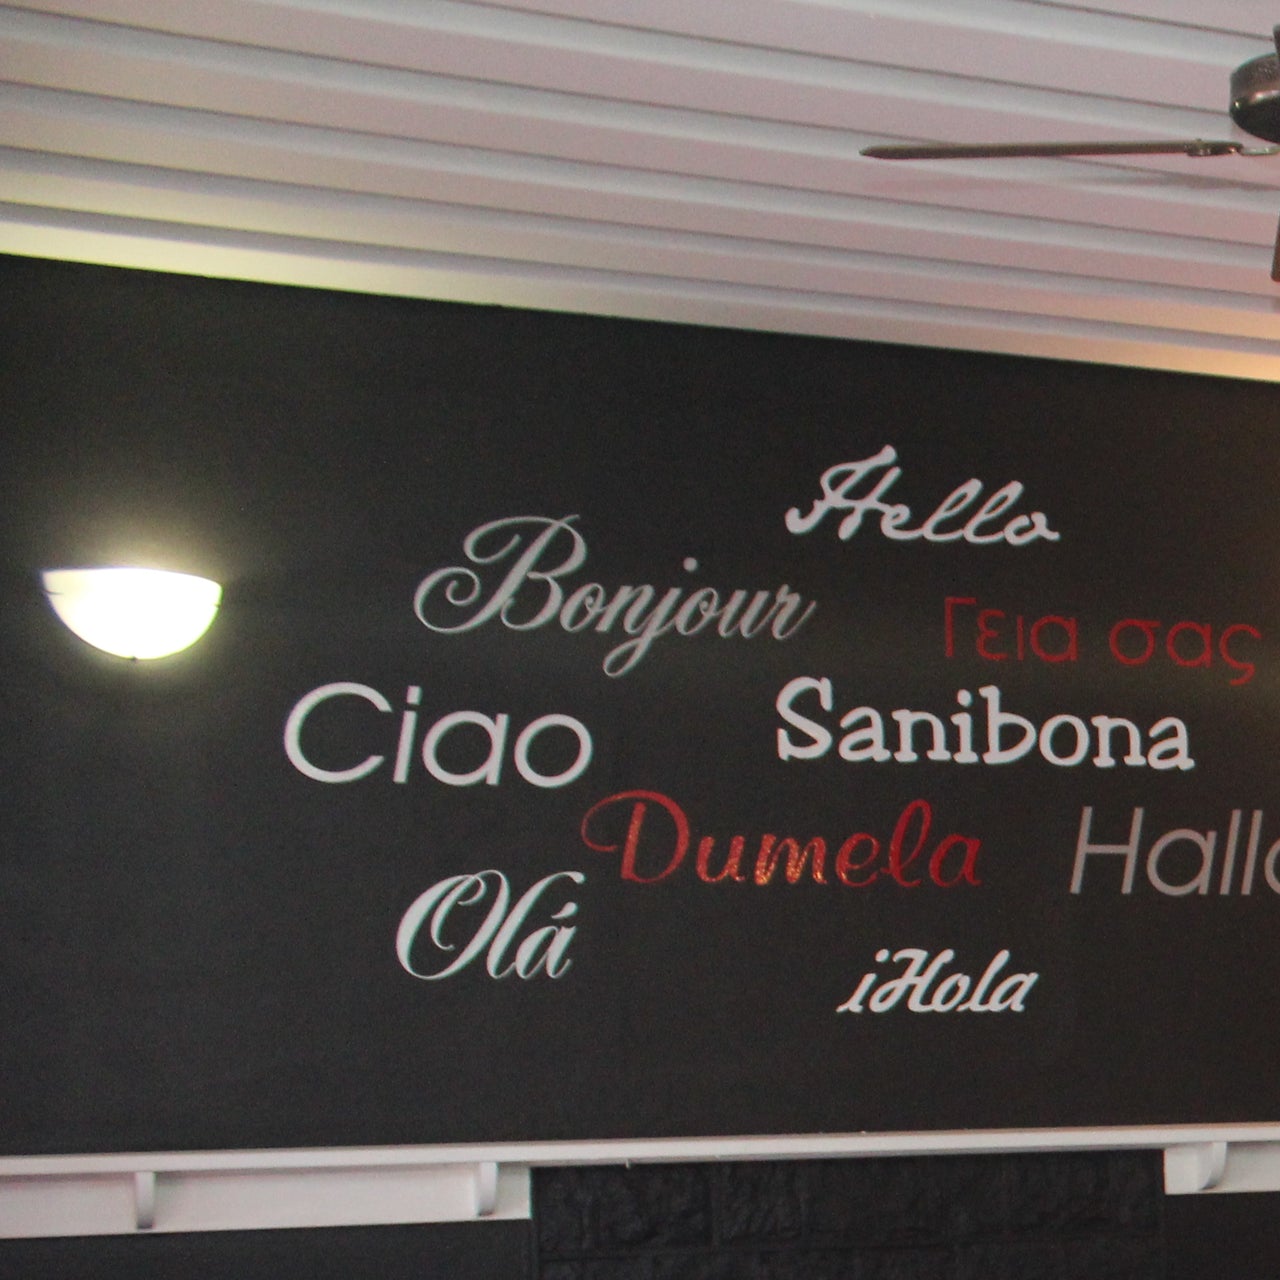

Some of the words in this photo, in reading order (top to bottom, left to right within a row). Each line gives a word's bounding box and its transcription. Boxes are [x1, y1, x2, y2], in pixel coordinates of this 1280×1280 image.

[784, 444, 1060, 546] Hello
[413, 513, 817, 678] Bonjour
[943, 596, 1079, 664] Γεια
[1108, 618, 1262, 686] σας
[283, 682, 593, 788] Ciao
[775, 676, 1195, 771] Sanibona
[581, 789, 982, 888] Dumela
[395, 869, 585, 980] Olá
